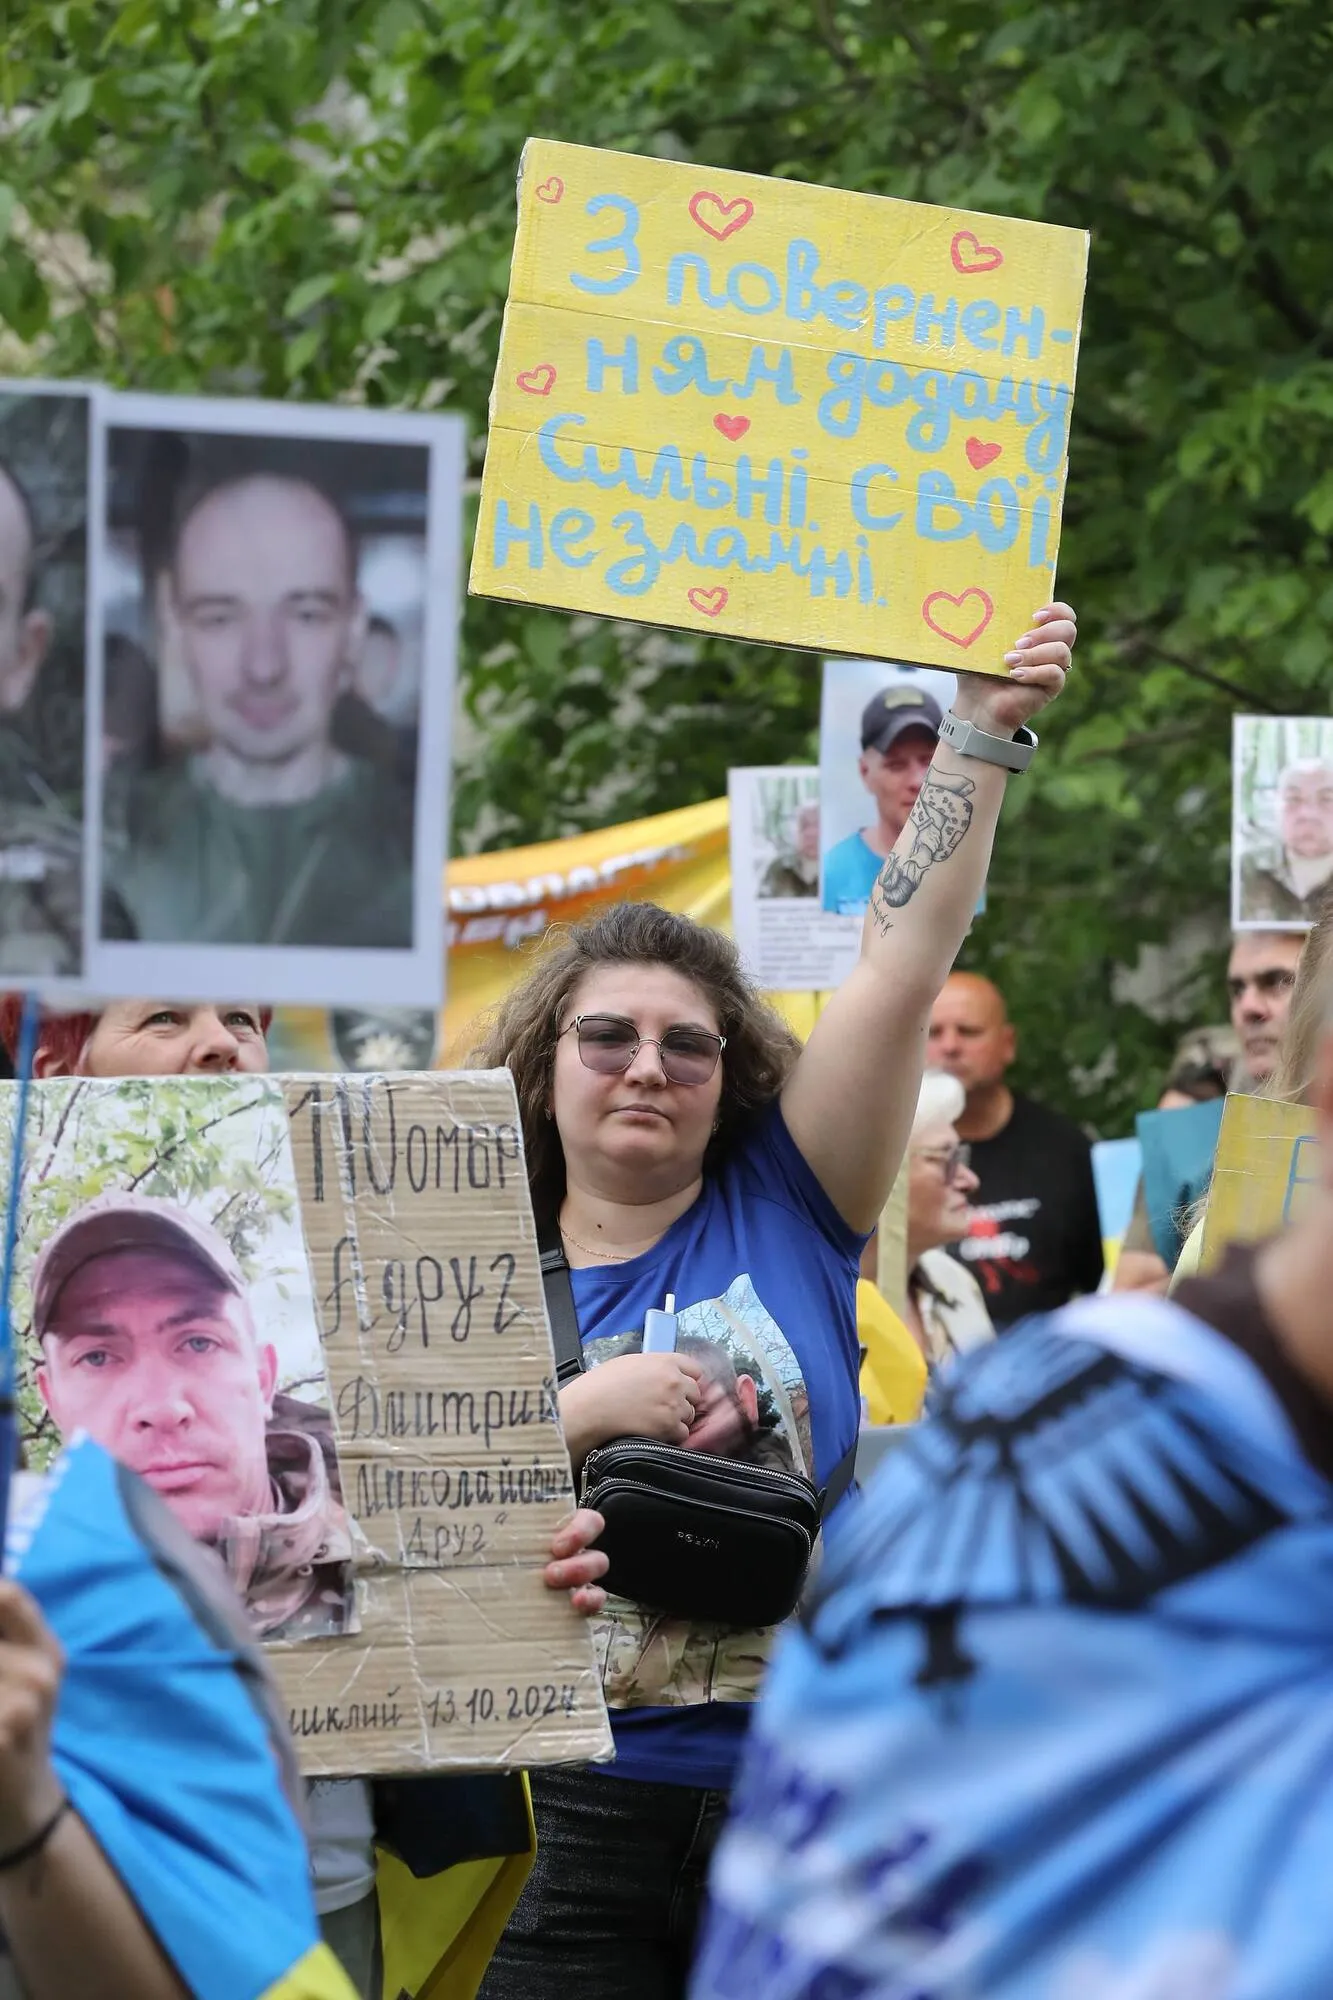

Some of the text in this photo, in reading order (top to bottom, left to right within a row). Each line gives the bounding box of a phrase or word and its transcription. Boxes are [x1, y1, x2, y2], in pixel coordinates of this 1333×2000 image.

[569, 193, 1074, 360] З повернен-
[816, 350, 1072, 477] додому
